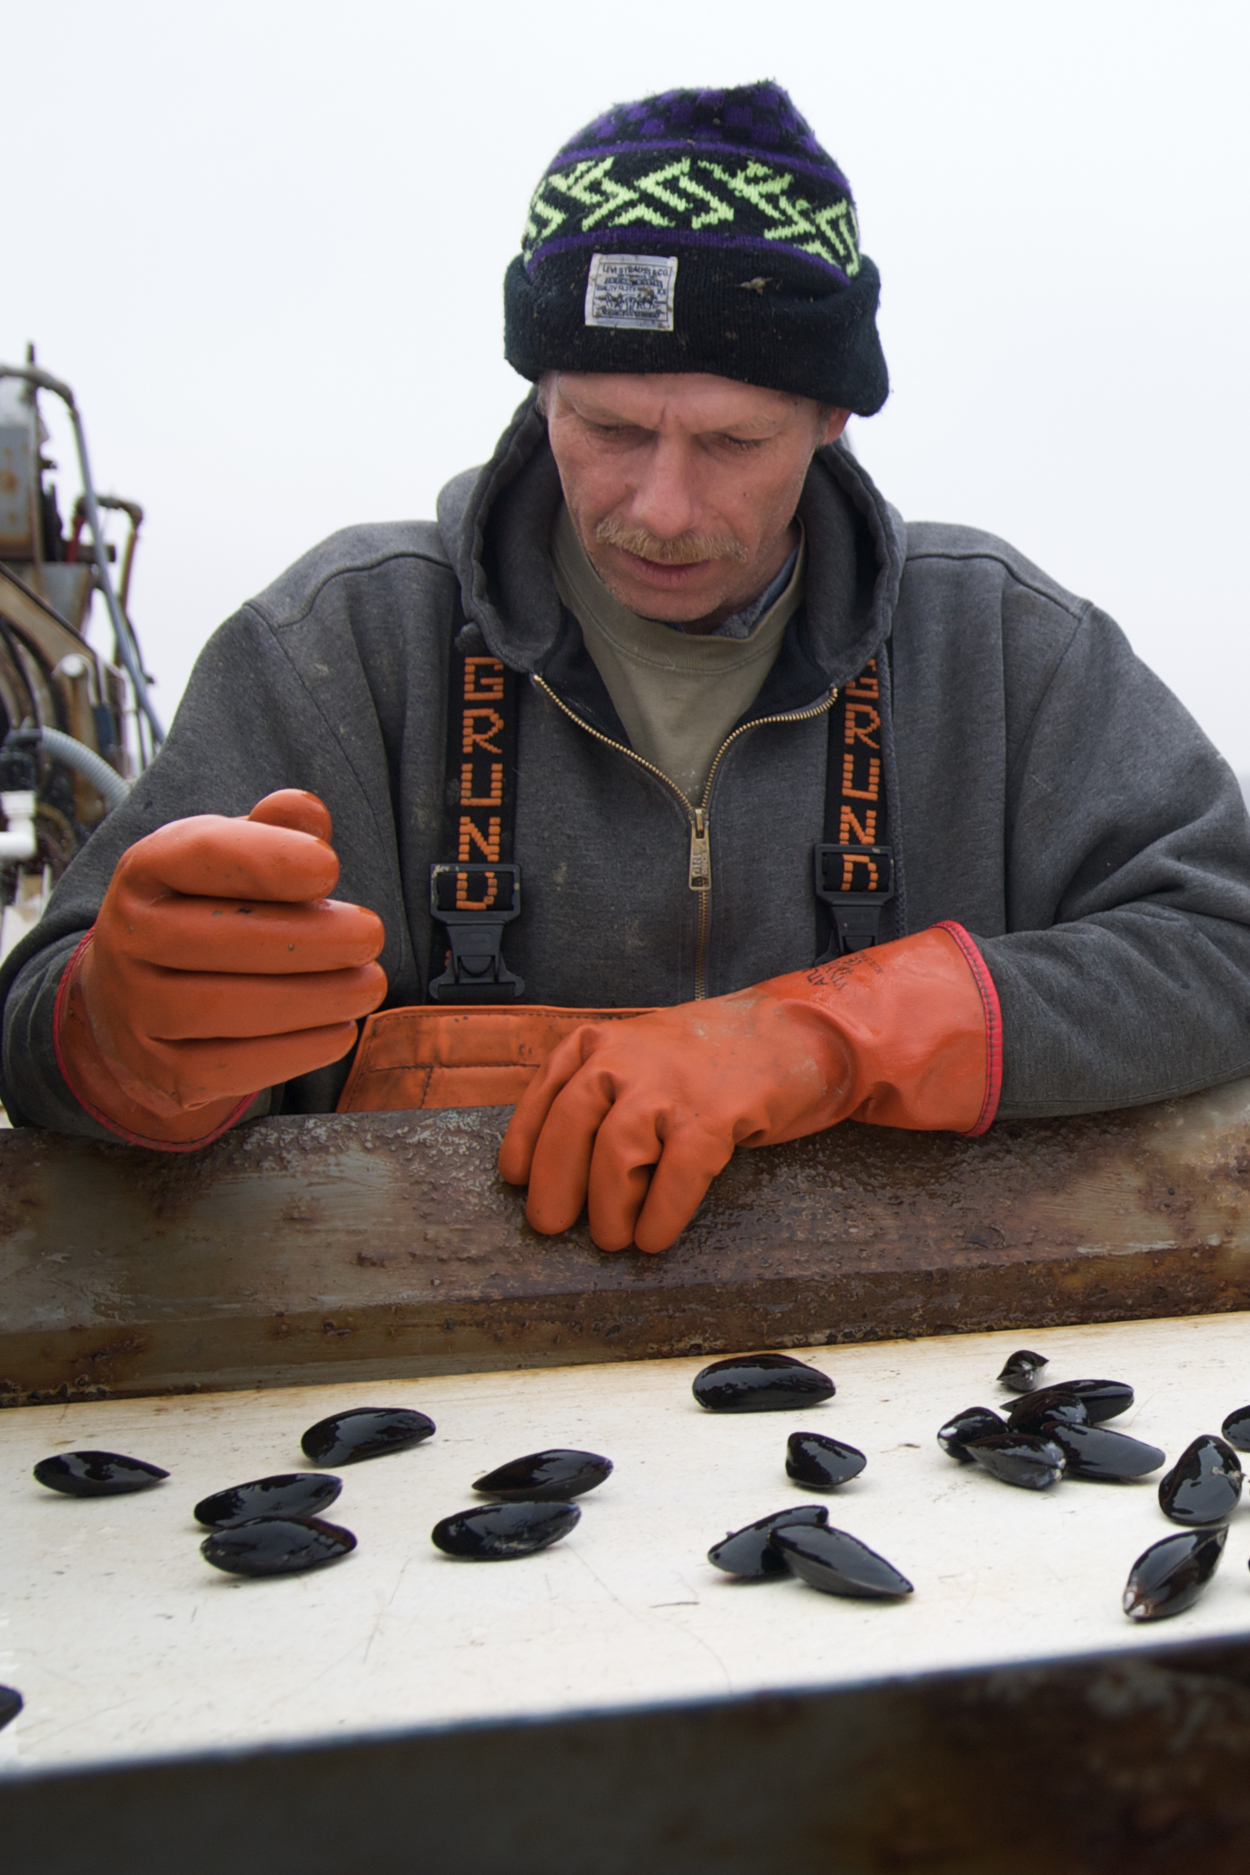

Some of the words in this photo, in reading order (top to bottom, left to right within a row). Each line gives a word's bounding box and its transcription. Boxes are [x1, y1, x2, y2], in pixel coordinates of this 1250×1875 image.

[602, 264, 618, 273] LEVI
[619, 265, 651, 275] STRAUSS
[455, 656, 504, 910] GRUND
